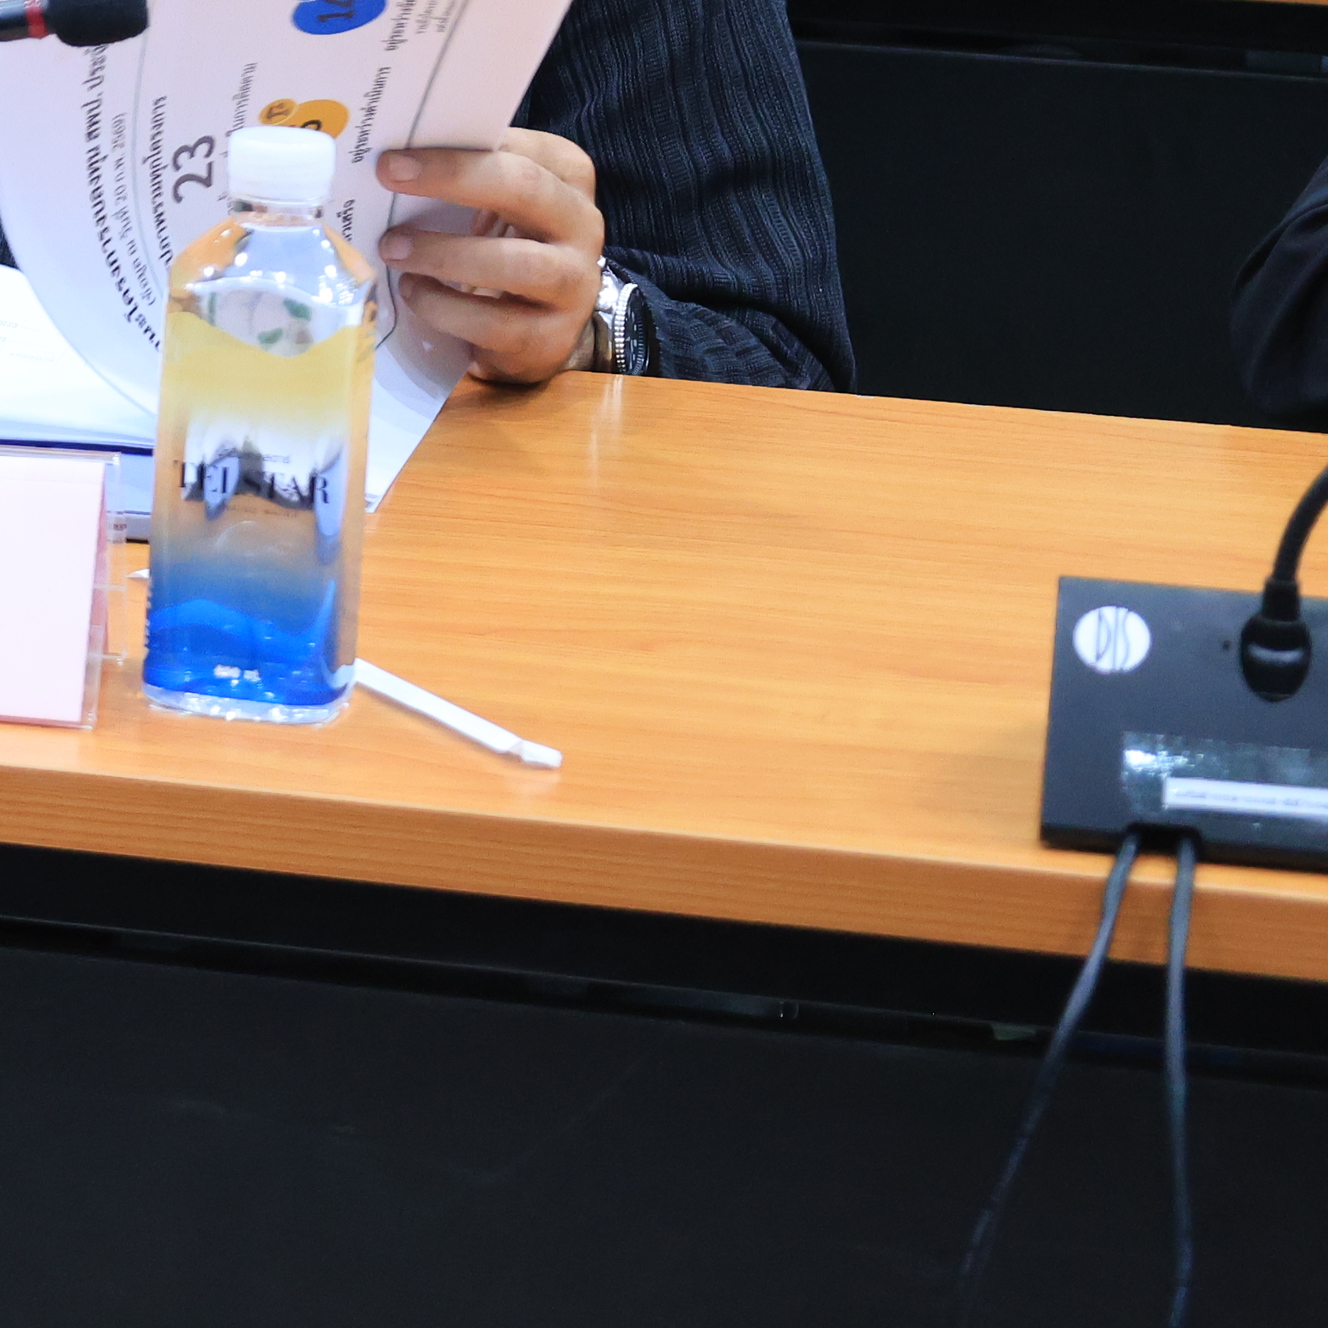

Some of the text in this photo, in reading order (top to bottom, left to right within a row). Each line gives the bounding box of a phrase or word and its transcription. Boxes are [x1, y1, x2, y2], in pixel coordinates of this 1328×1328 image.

[142, 94, 174, 269] ปภาพรวมทุกโครงการ
[172, 134, 216, 204] 23
